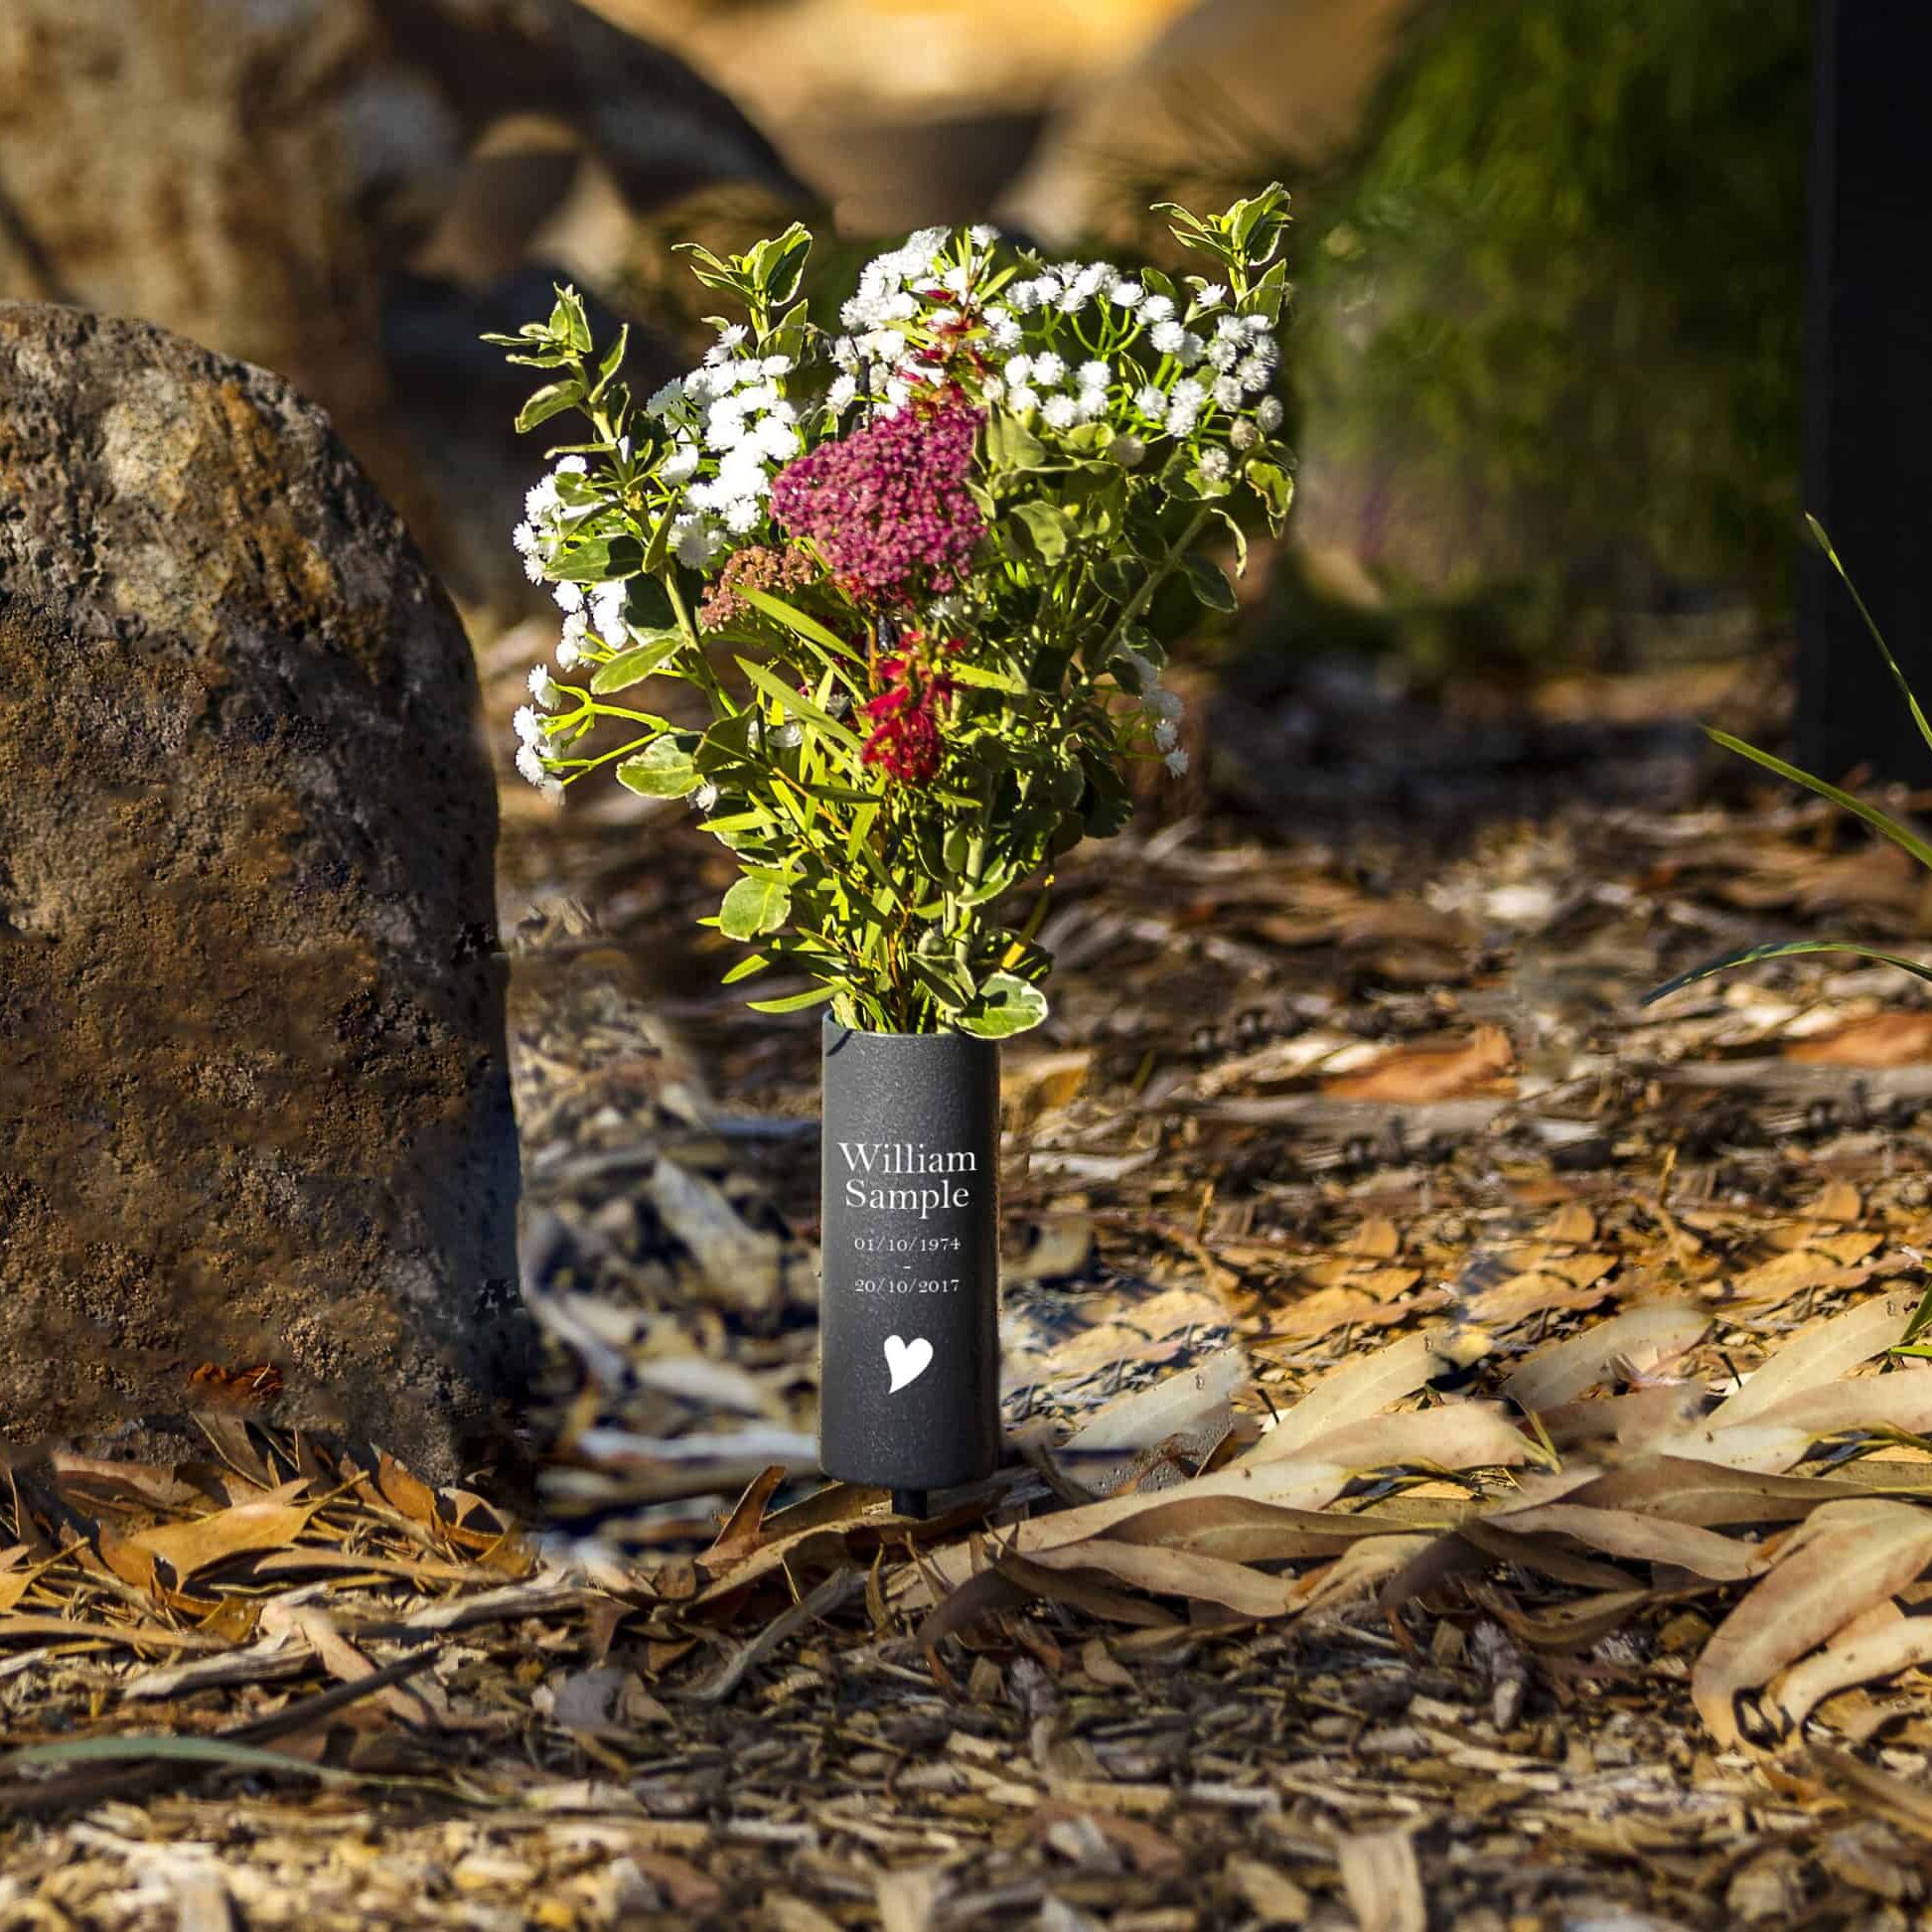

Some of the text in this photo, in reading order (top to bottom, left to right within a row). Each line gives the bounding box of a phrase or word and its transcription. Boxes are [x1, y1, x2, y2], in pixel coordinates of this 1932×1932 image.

[837, 1141, 977, 1175] William
[845, 1178, 969, 1220] Sample
[854, 1237, 962, 1253] 01/10/1974
[854, 1277, 961, 1294] 20/10/2017
